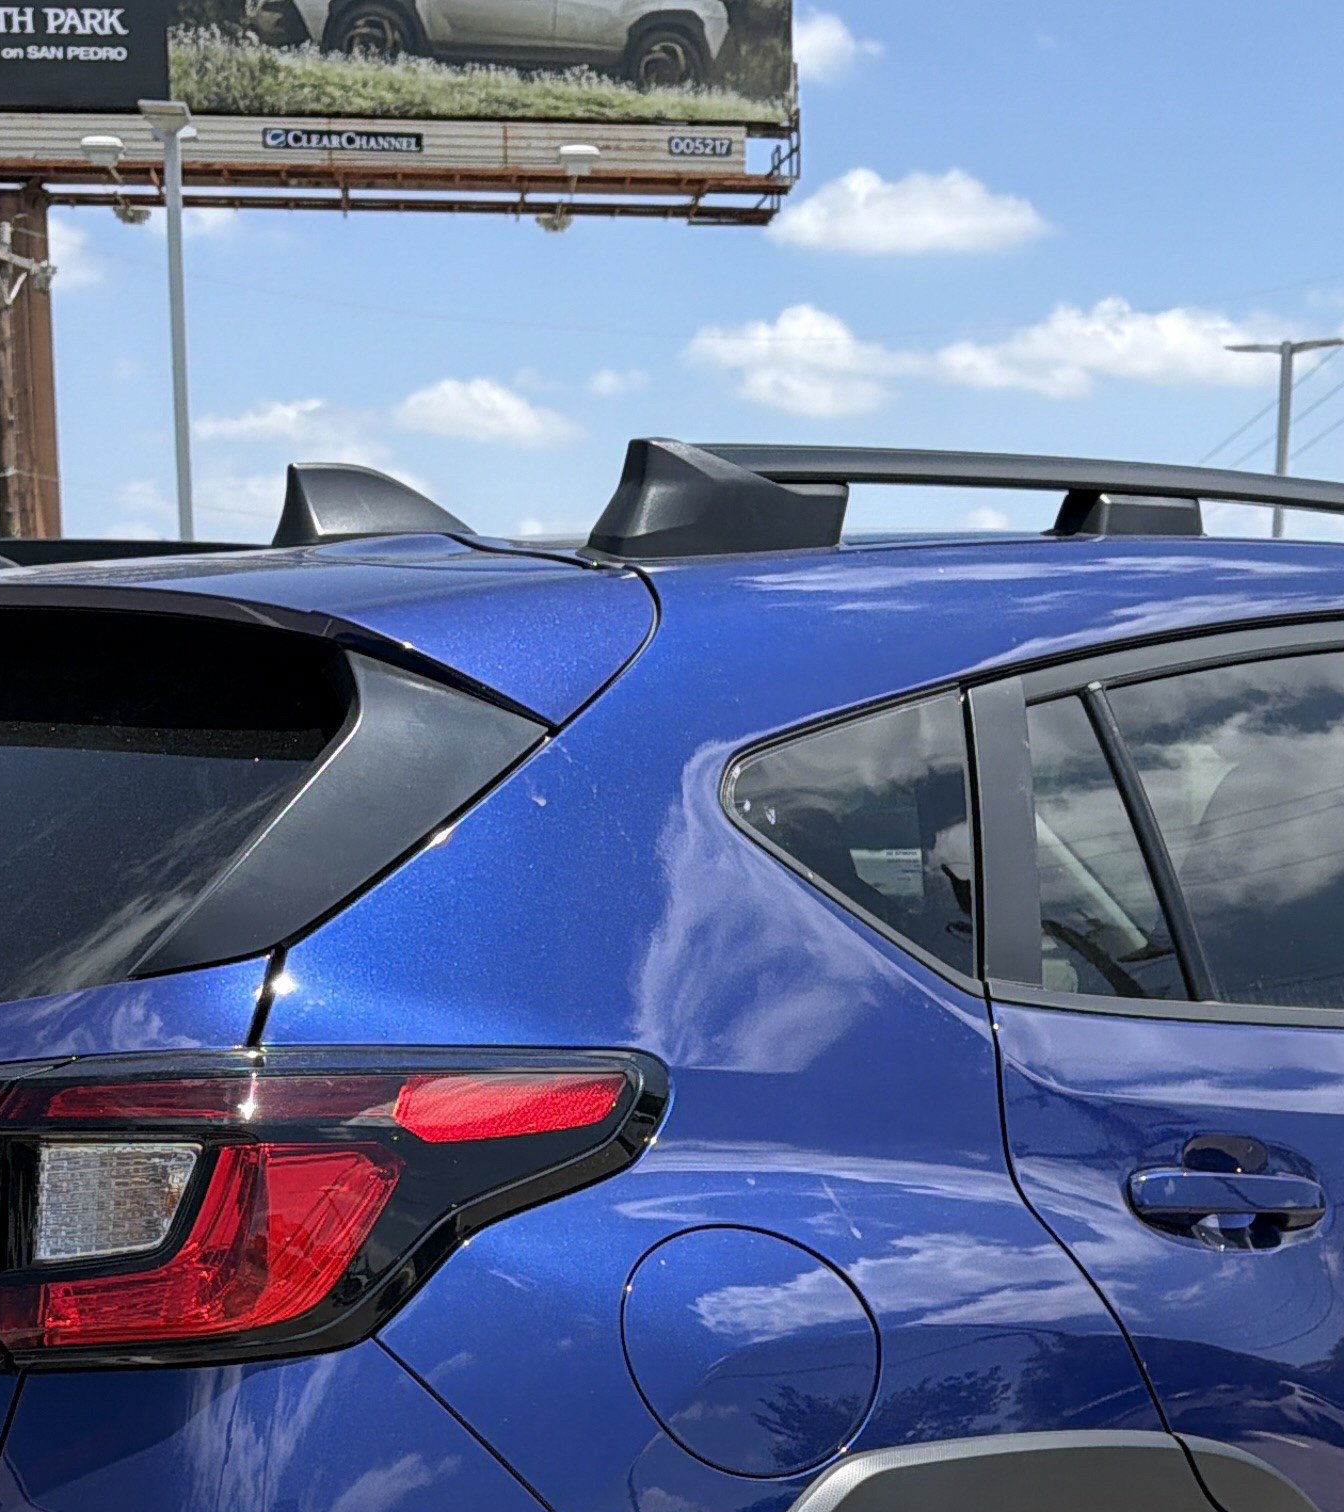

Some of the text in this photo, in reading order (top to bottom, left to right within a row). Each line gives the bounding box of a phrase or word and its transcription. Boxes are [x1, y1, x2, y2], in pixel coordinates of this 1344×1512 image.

[42, 8, 129, 35] PARK
[1, 47, 24, 59] on
[27, 46, 63, 60] SAN
[67, 47, 128, 61] PEDRO
[670, 138, 730, 155] 005217
